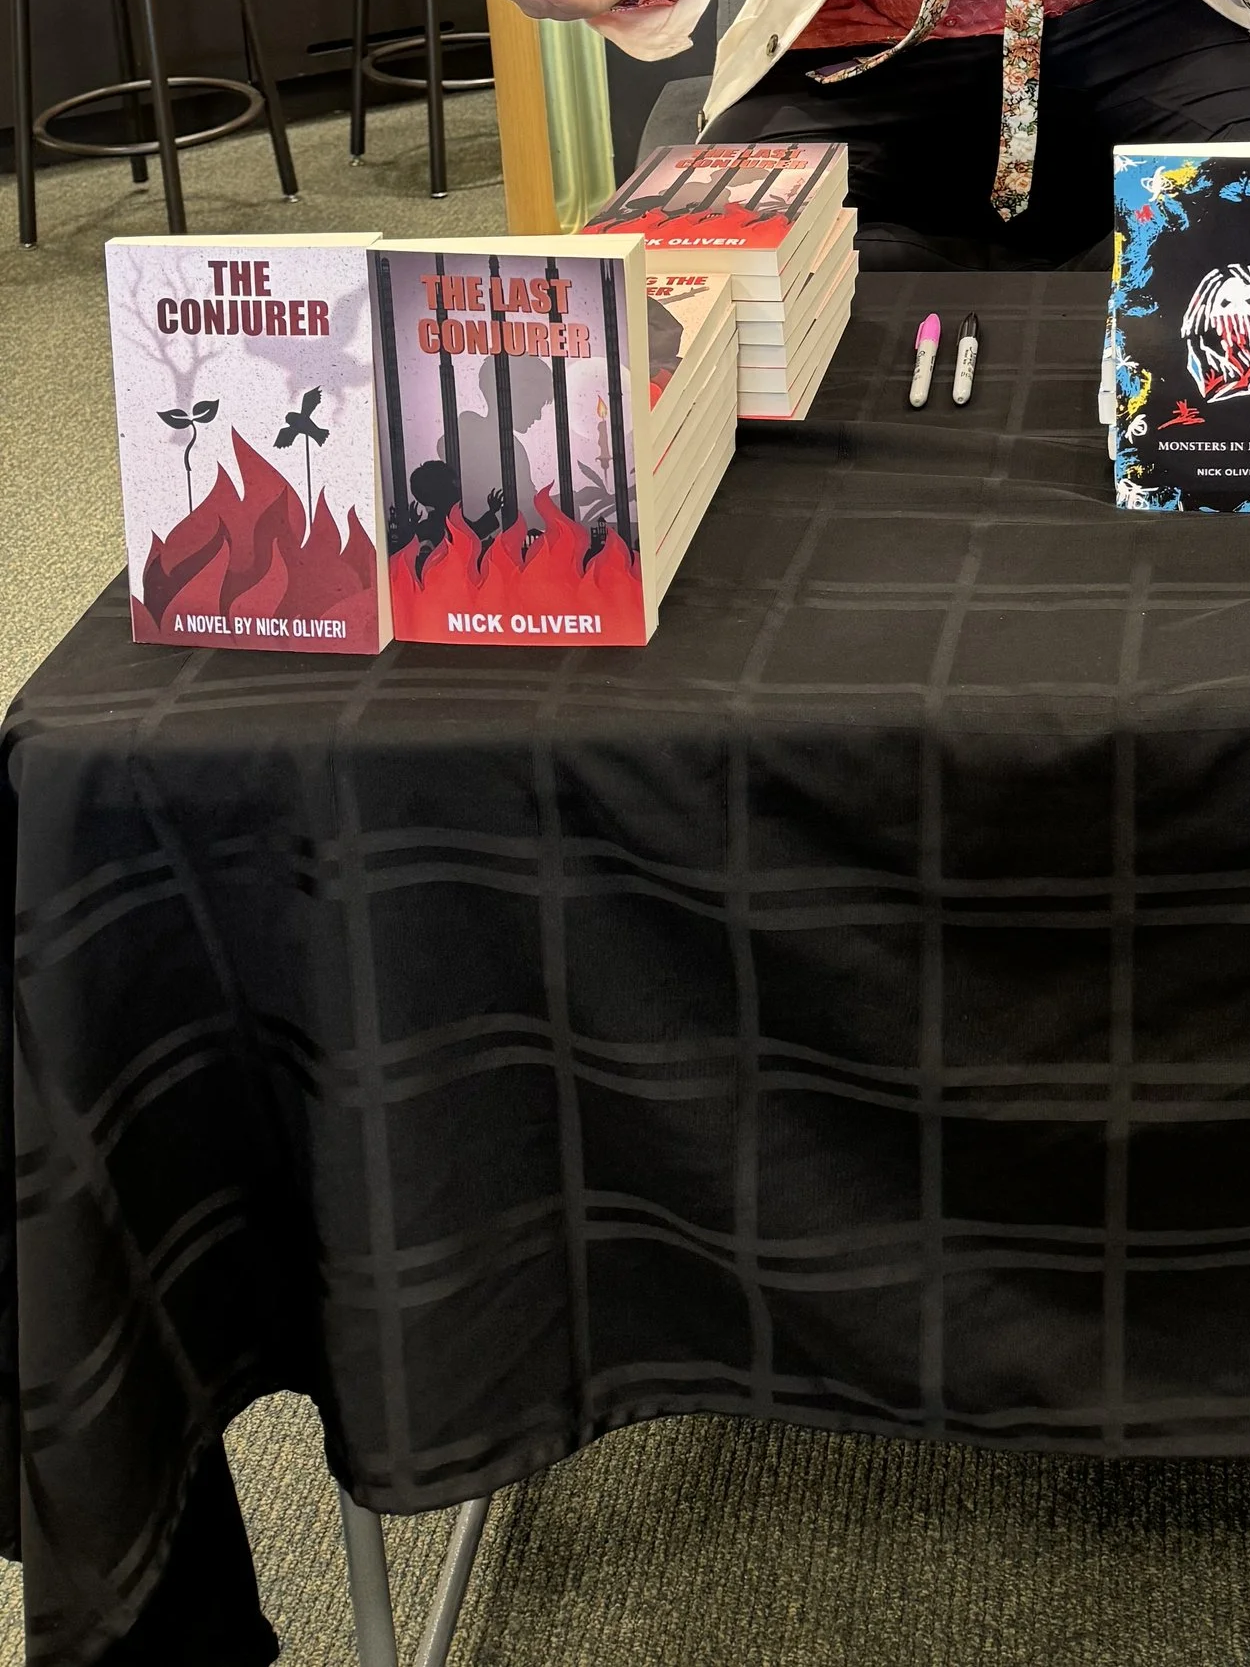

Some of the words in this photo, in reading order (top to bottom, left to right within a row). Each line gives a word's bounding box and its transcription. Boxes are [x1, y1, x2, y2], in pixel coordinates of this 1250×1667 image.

[689, 148, 739, 159] THE
[739, 148, 802, 159] LAST
[675, 158, 809, 170] CONJURER
[667, 238, 747, 246] OLIVERI
[207, 260, 272, 297] THE
[666, 276, 709, 286] THE
[419, 274, 486, 312] THE
[488, 276, 573, 315] LAST
[156, 297, 330, 336] CONJURER
[417, 318, 592, 359] CONJURER
[1157, 441, 1227, 452] MONSTERS
[1229, 441, 1244, 452] IN
[1197, 468, 1222, 476] NICK
[174, 613, 184, 632] A
[186, 614, 231, 634] NOVEL
[234, 616, 252, 635] BY
[256, 617, 289, 637] NICK
[292, 619, 346, 638] OLIVERI
[447, 612, 504, 633] NICK
[510, 614, 602, 634] OLIVERI
